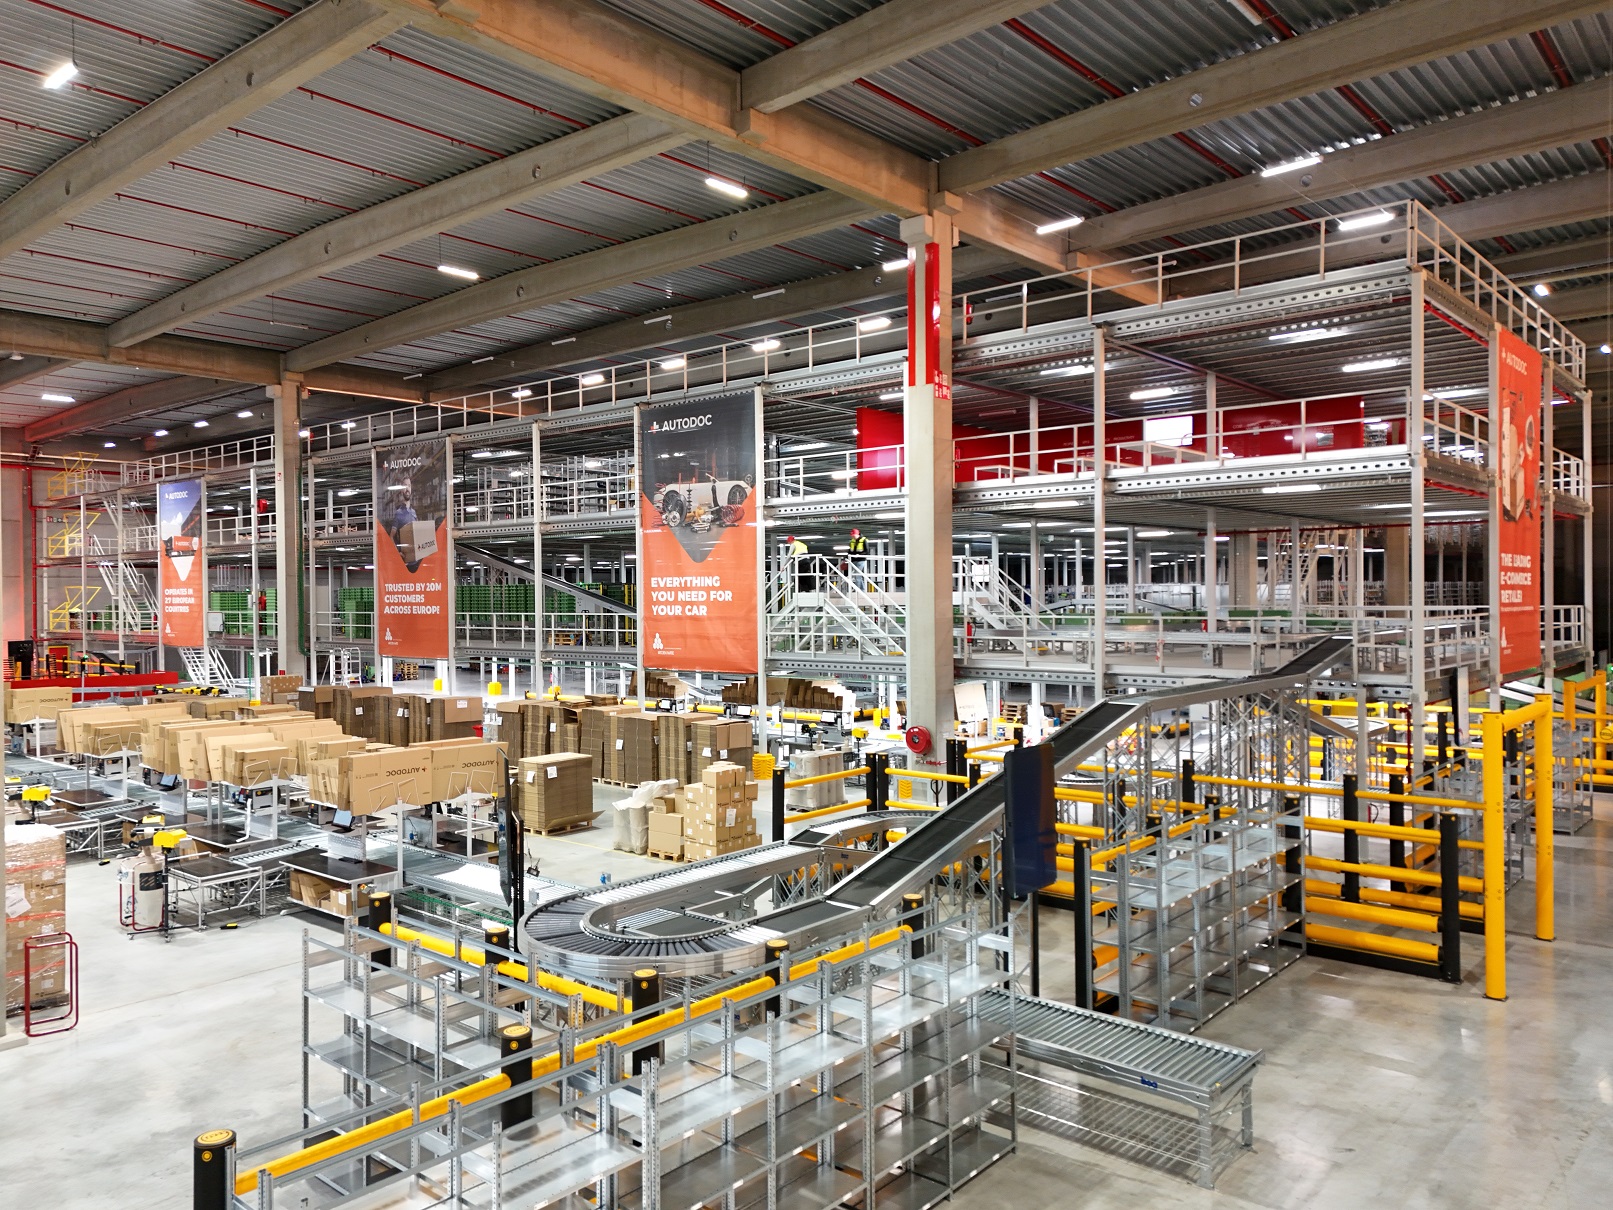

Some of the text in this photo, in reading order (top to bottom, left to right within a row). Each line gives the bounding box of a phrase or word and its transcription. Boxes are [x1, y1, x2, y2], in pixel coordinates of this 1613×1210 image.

[661, 414, 712, 431] AUTODOC
[390, 456, 422, 469] AUTODOC
[168, 490, 188, 500] AUTODOC
[1500, 552, 1513, 567] THE
[384, 582, 442, 592] TRUSTED BY 20M
[651, 575, 721, 588] EVERYTHING
[384, 594, 425, 603] CUSTOMERS
[651, 590, 733, 602] YOU NEED FOR
[384, 605, 440, 615] ACROSS EUROPE
[651, 605, 708, 616] YOUR CAR
[461, 759, 495, 769] AUTODOC
[385, 766, 421, 777] AUTODOC
